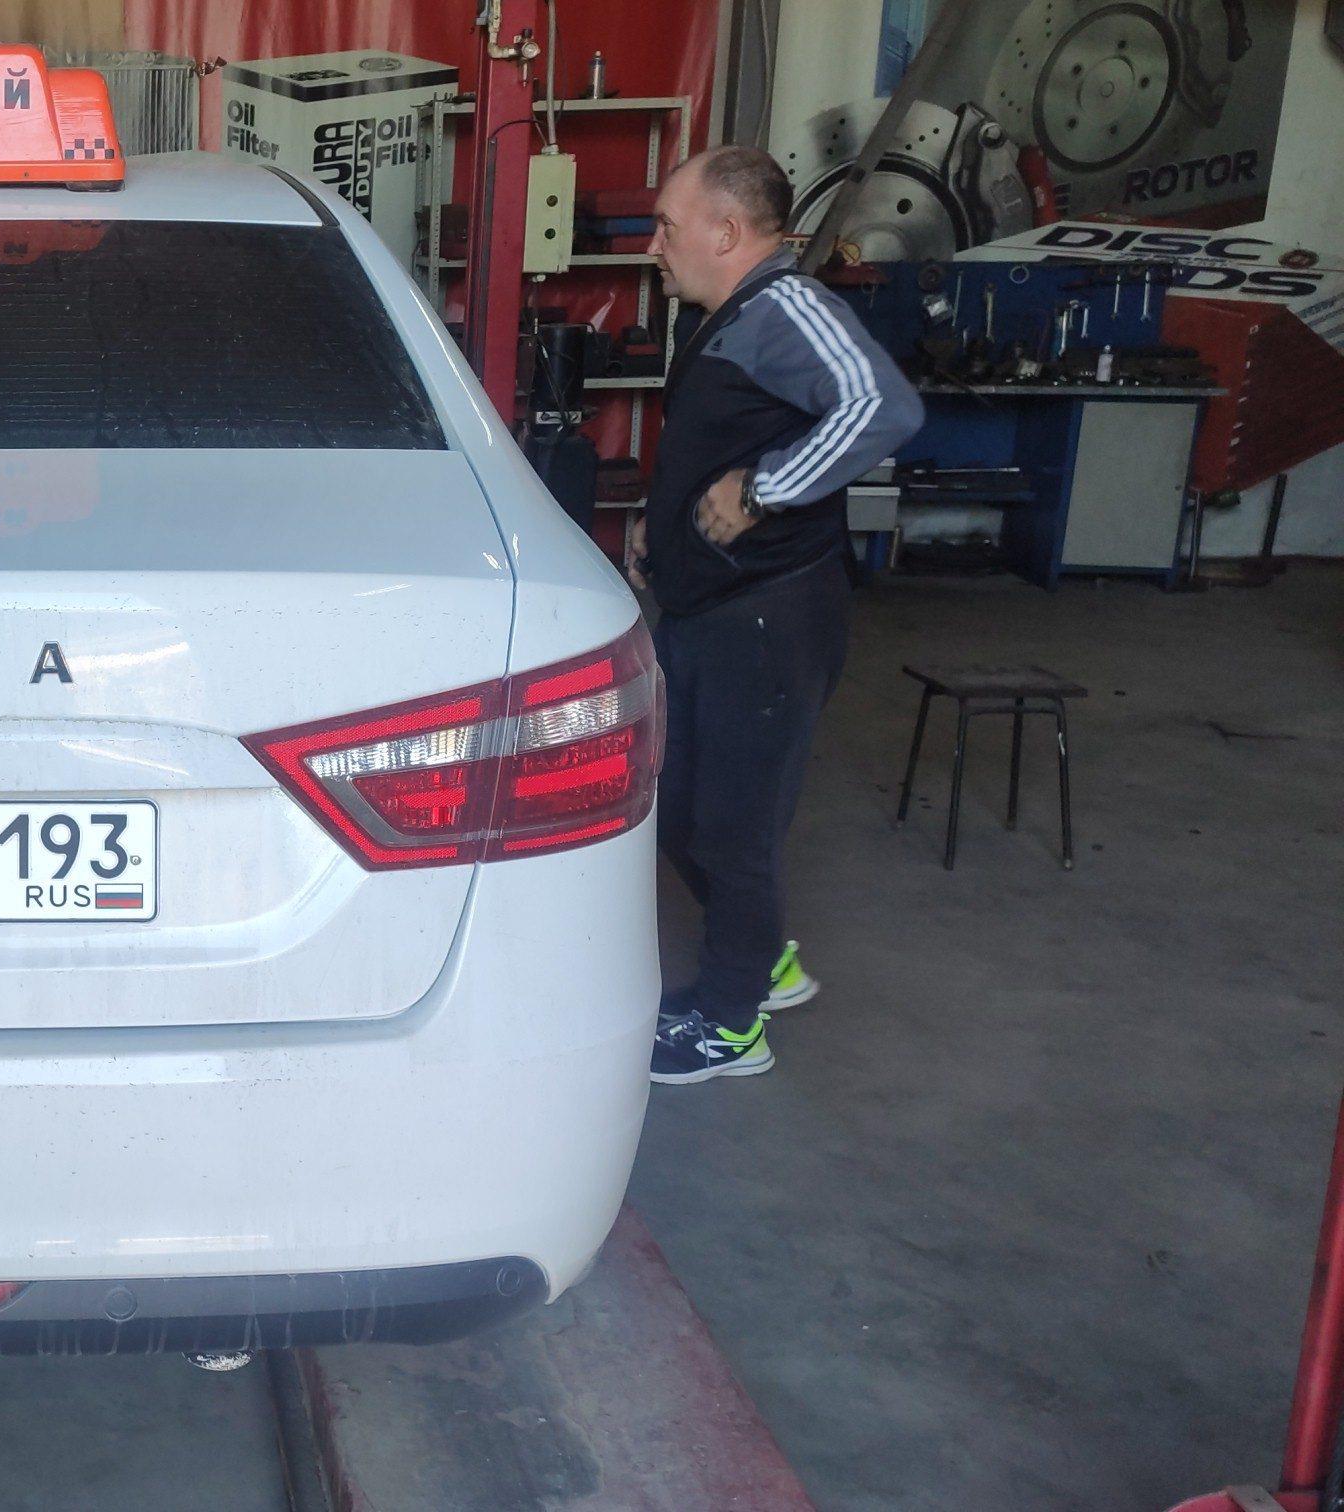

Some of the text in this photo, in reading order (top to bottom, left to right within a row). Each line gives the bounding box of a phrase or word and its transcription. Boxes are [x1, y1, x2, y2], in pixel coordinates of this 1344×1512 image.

[227, 99, 256, 127] Oil
[376, 114, 413, 142] Oil
[227, 125, 280, 161] Filter
[375, 141, 433, 169] Filte
[357, 122, 375, 198] DUTY
[1122, 149, 1258, 204] ROTOR
[1036, 226, 1273, 261] DISC
[25, 884, 91, 908] RUS
